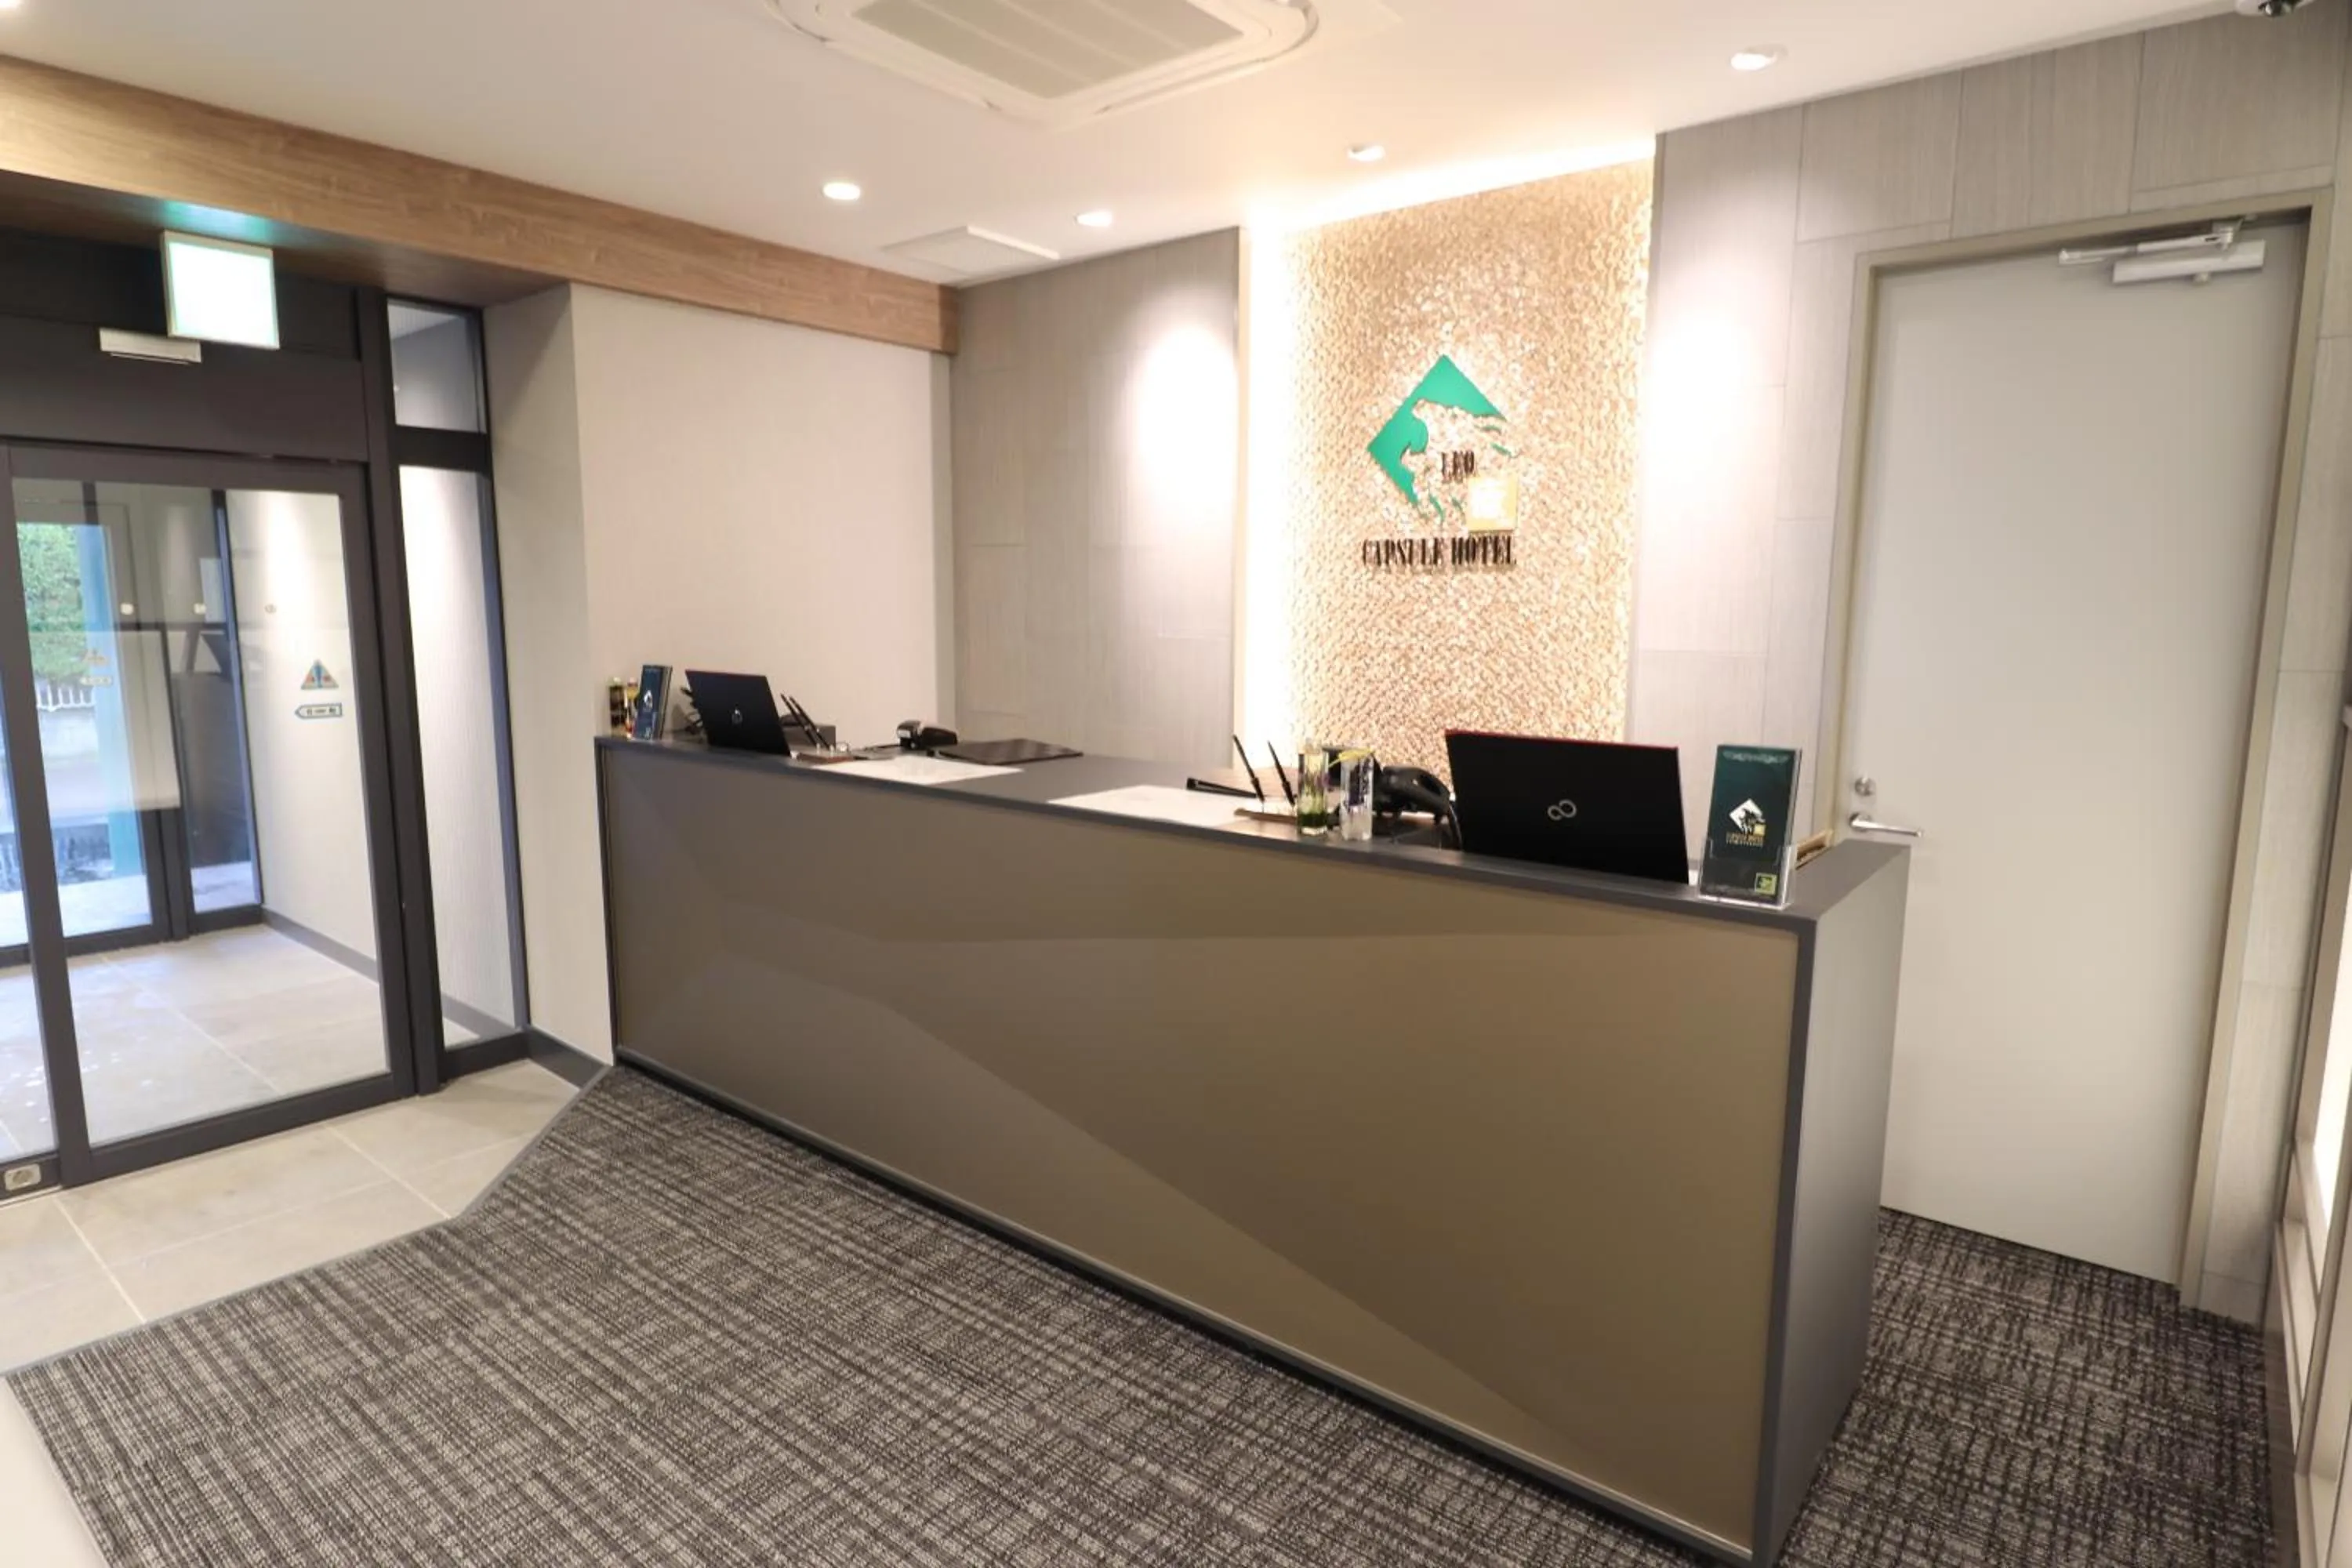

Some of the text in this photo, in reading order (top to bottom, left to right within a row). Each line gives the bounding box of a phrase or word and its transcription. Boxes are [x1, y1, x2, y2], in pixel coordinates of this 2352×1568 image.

[1441, 451, 1475, 474] LEO
[1363, 535, 1517, 565] CAPSULE HOTEL
